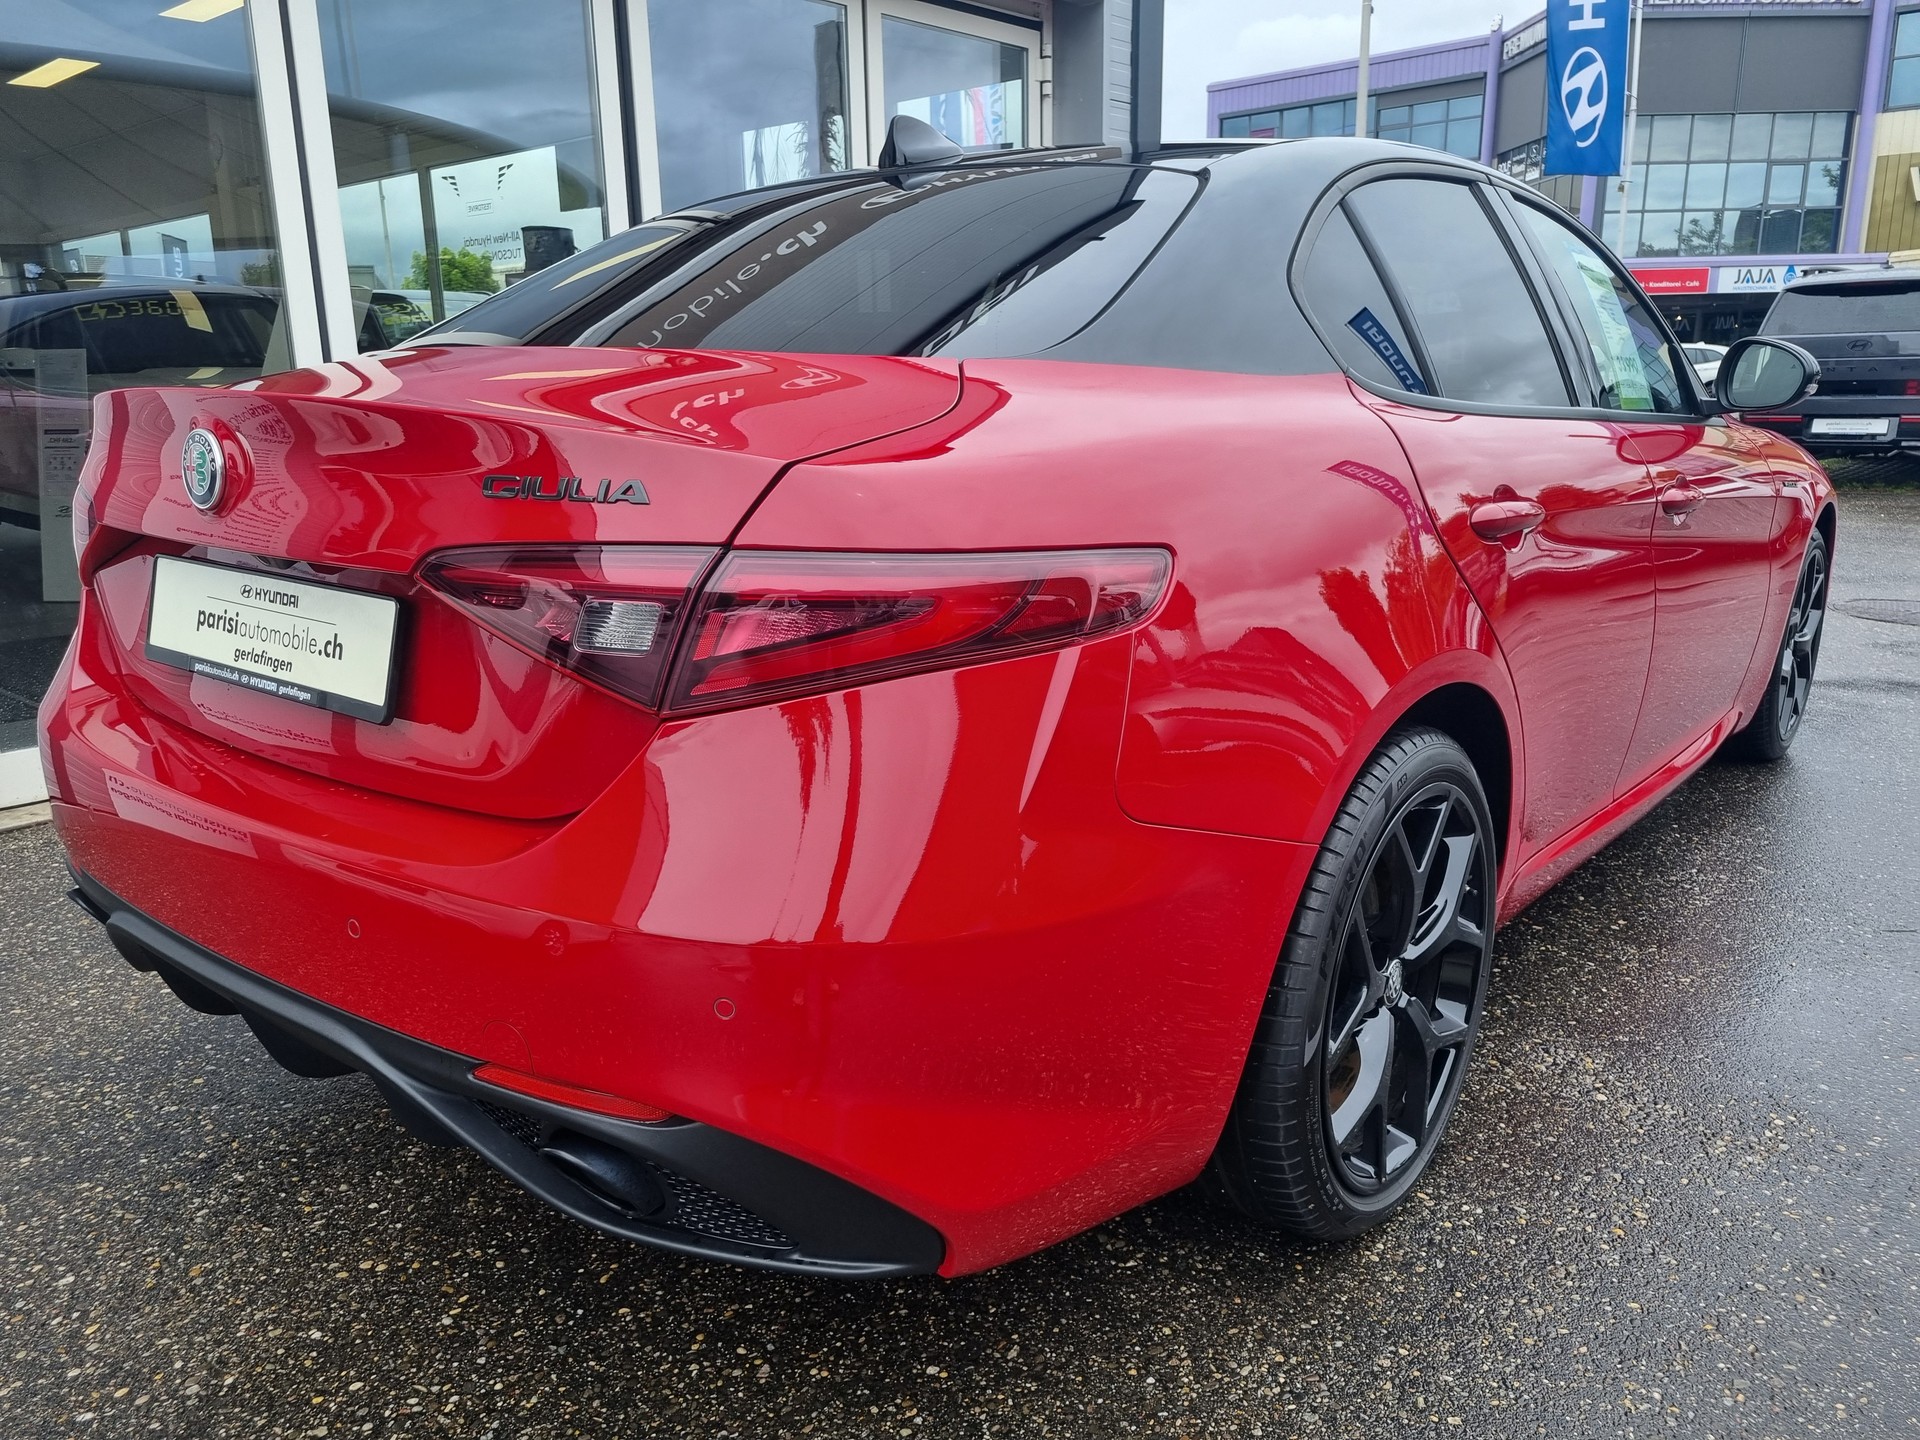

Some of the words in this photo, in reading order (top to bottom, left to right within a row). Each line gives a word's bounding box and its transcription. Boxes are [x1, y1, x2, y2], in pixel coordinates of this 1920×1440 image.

[1734, 269, 1776, 284] JAJA
[194, 434, 217, 472] ROMEO
[481, 475, 651, 504] GIULIA
[254, 587, 299, 608] HYUNDAI
[196, 608, 343, 660] parisiautomobile.ch
[234, 646, 293, 673] gerlafingen
[194, 662, 239, 681] parisiautomobile.ch
[250, 676, 277, 692] HYUNDAI
[278, 685, 311, 701] gerlafingen
